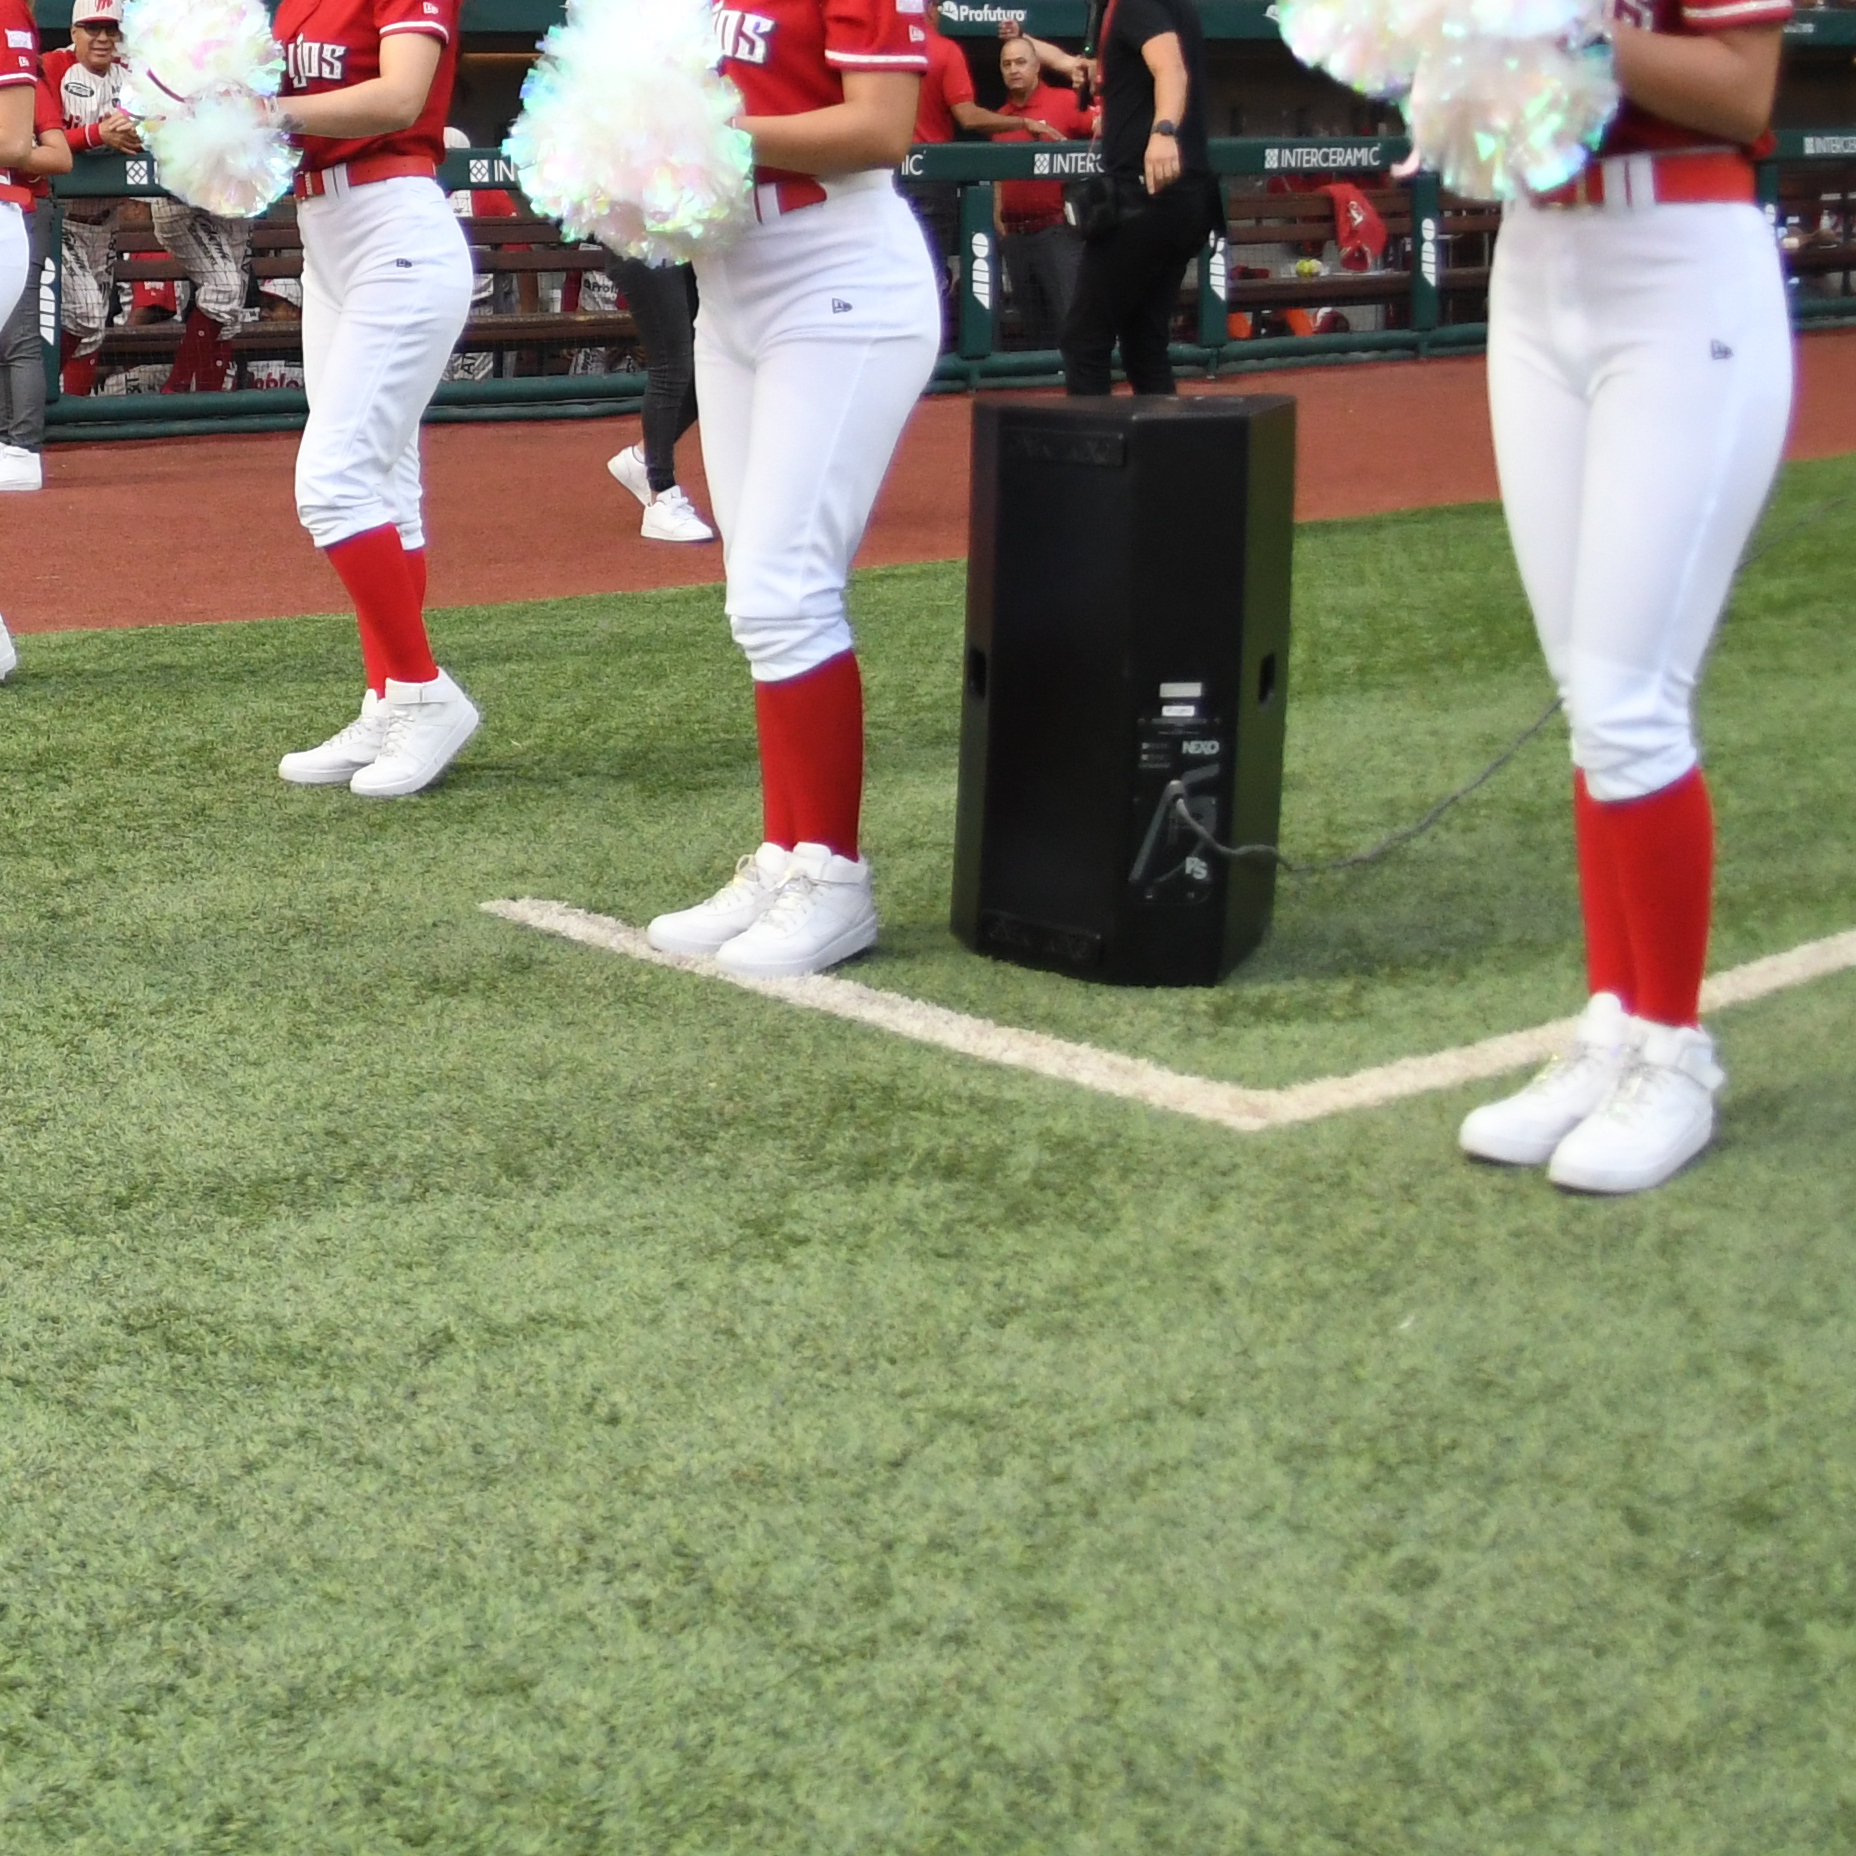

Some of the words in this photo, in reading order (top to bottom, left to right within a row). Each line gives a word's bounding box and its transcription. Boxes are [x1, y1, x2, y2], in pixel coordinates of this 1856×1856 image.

[959, 7, 1025, 22] Profuturo
[1281, 148, 1380, 168] INTERCERAMIC
[1181, 740, 1220, 754] NEXO
